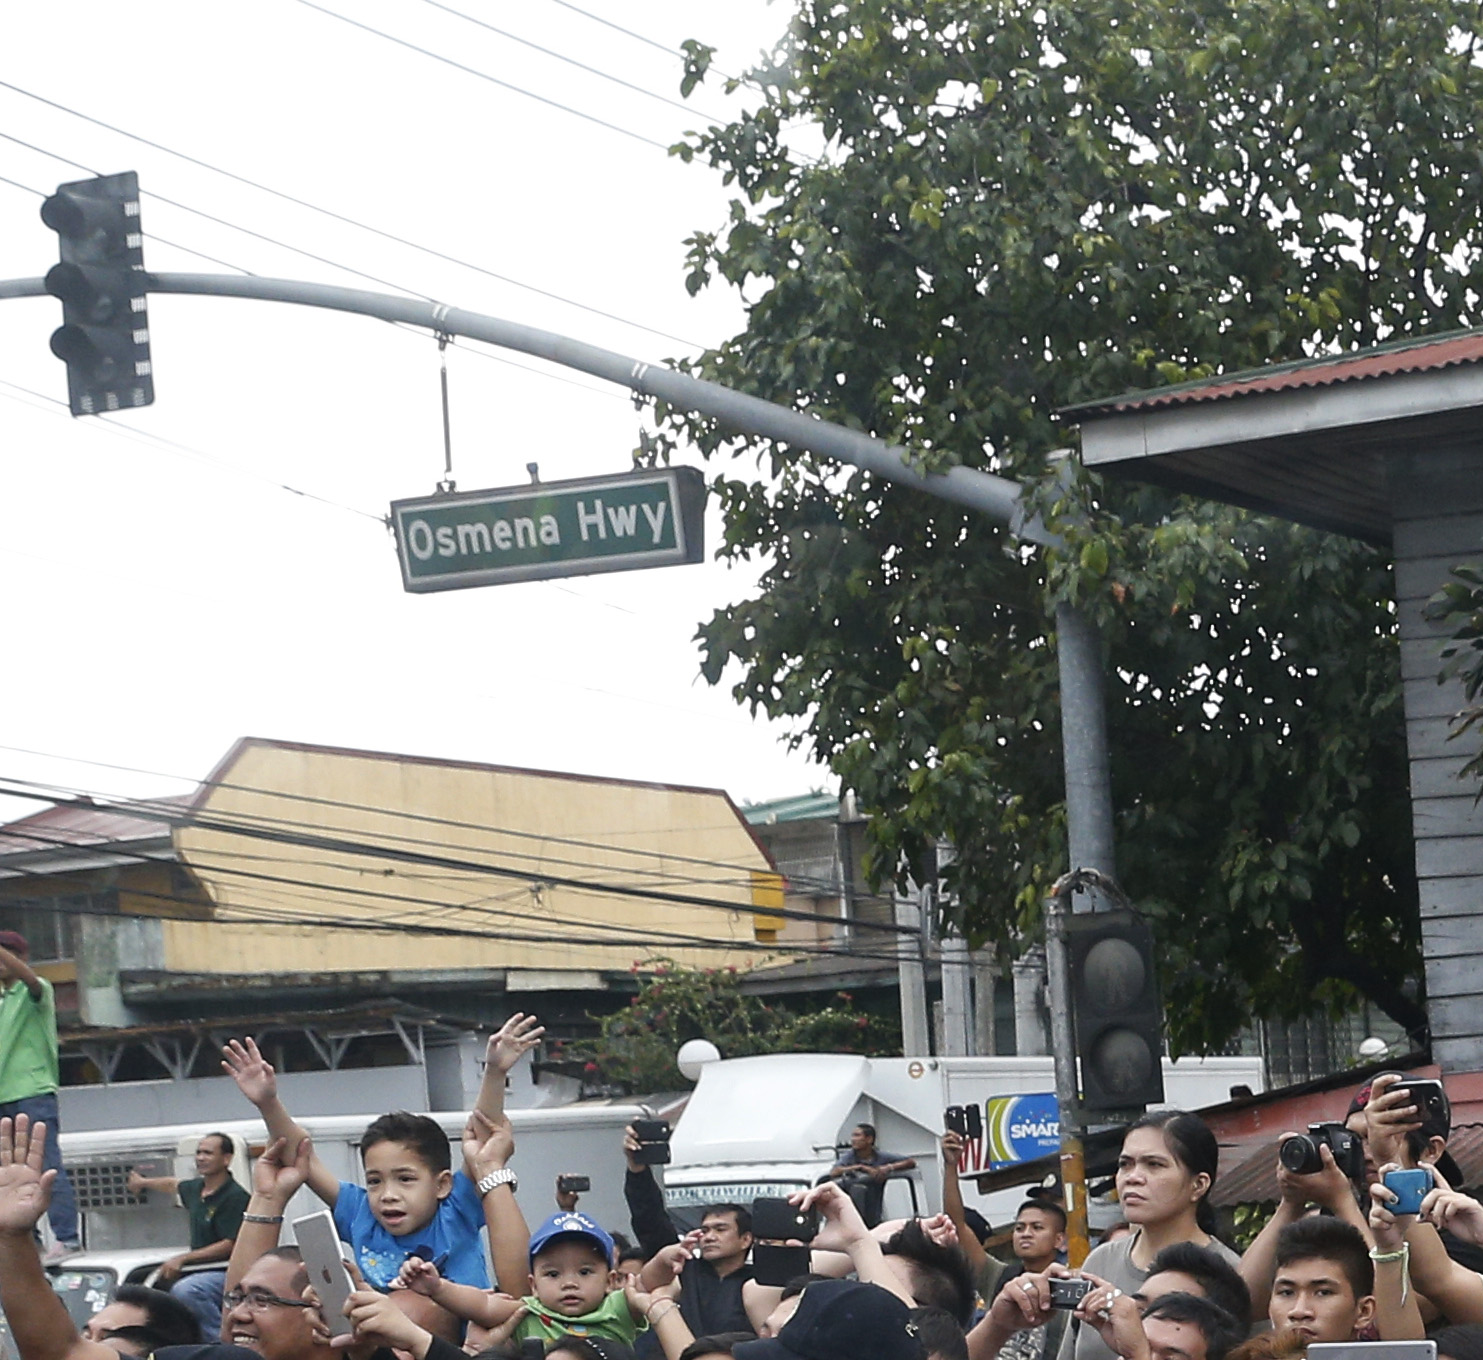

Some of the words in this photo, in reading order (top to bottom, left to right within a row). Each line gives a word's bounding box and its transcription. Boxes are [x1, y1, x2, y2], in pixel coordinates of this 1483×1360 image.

[408, 517, 560, 561] Osmena
[576, 499, 667, 544] Hwy
[1010, 1121, 1060, 1139] SMAR
